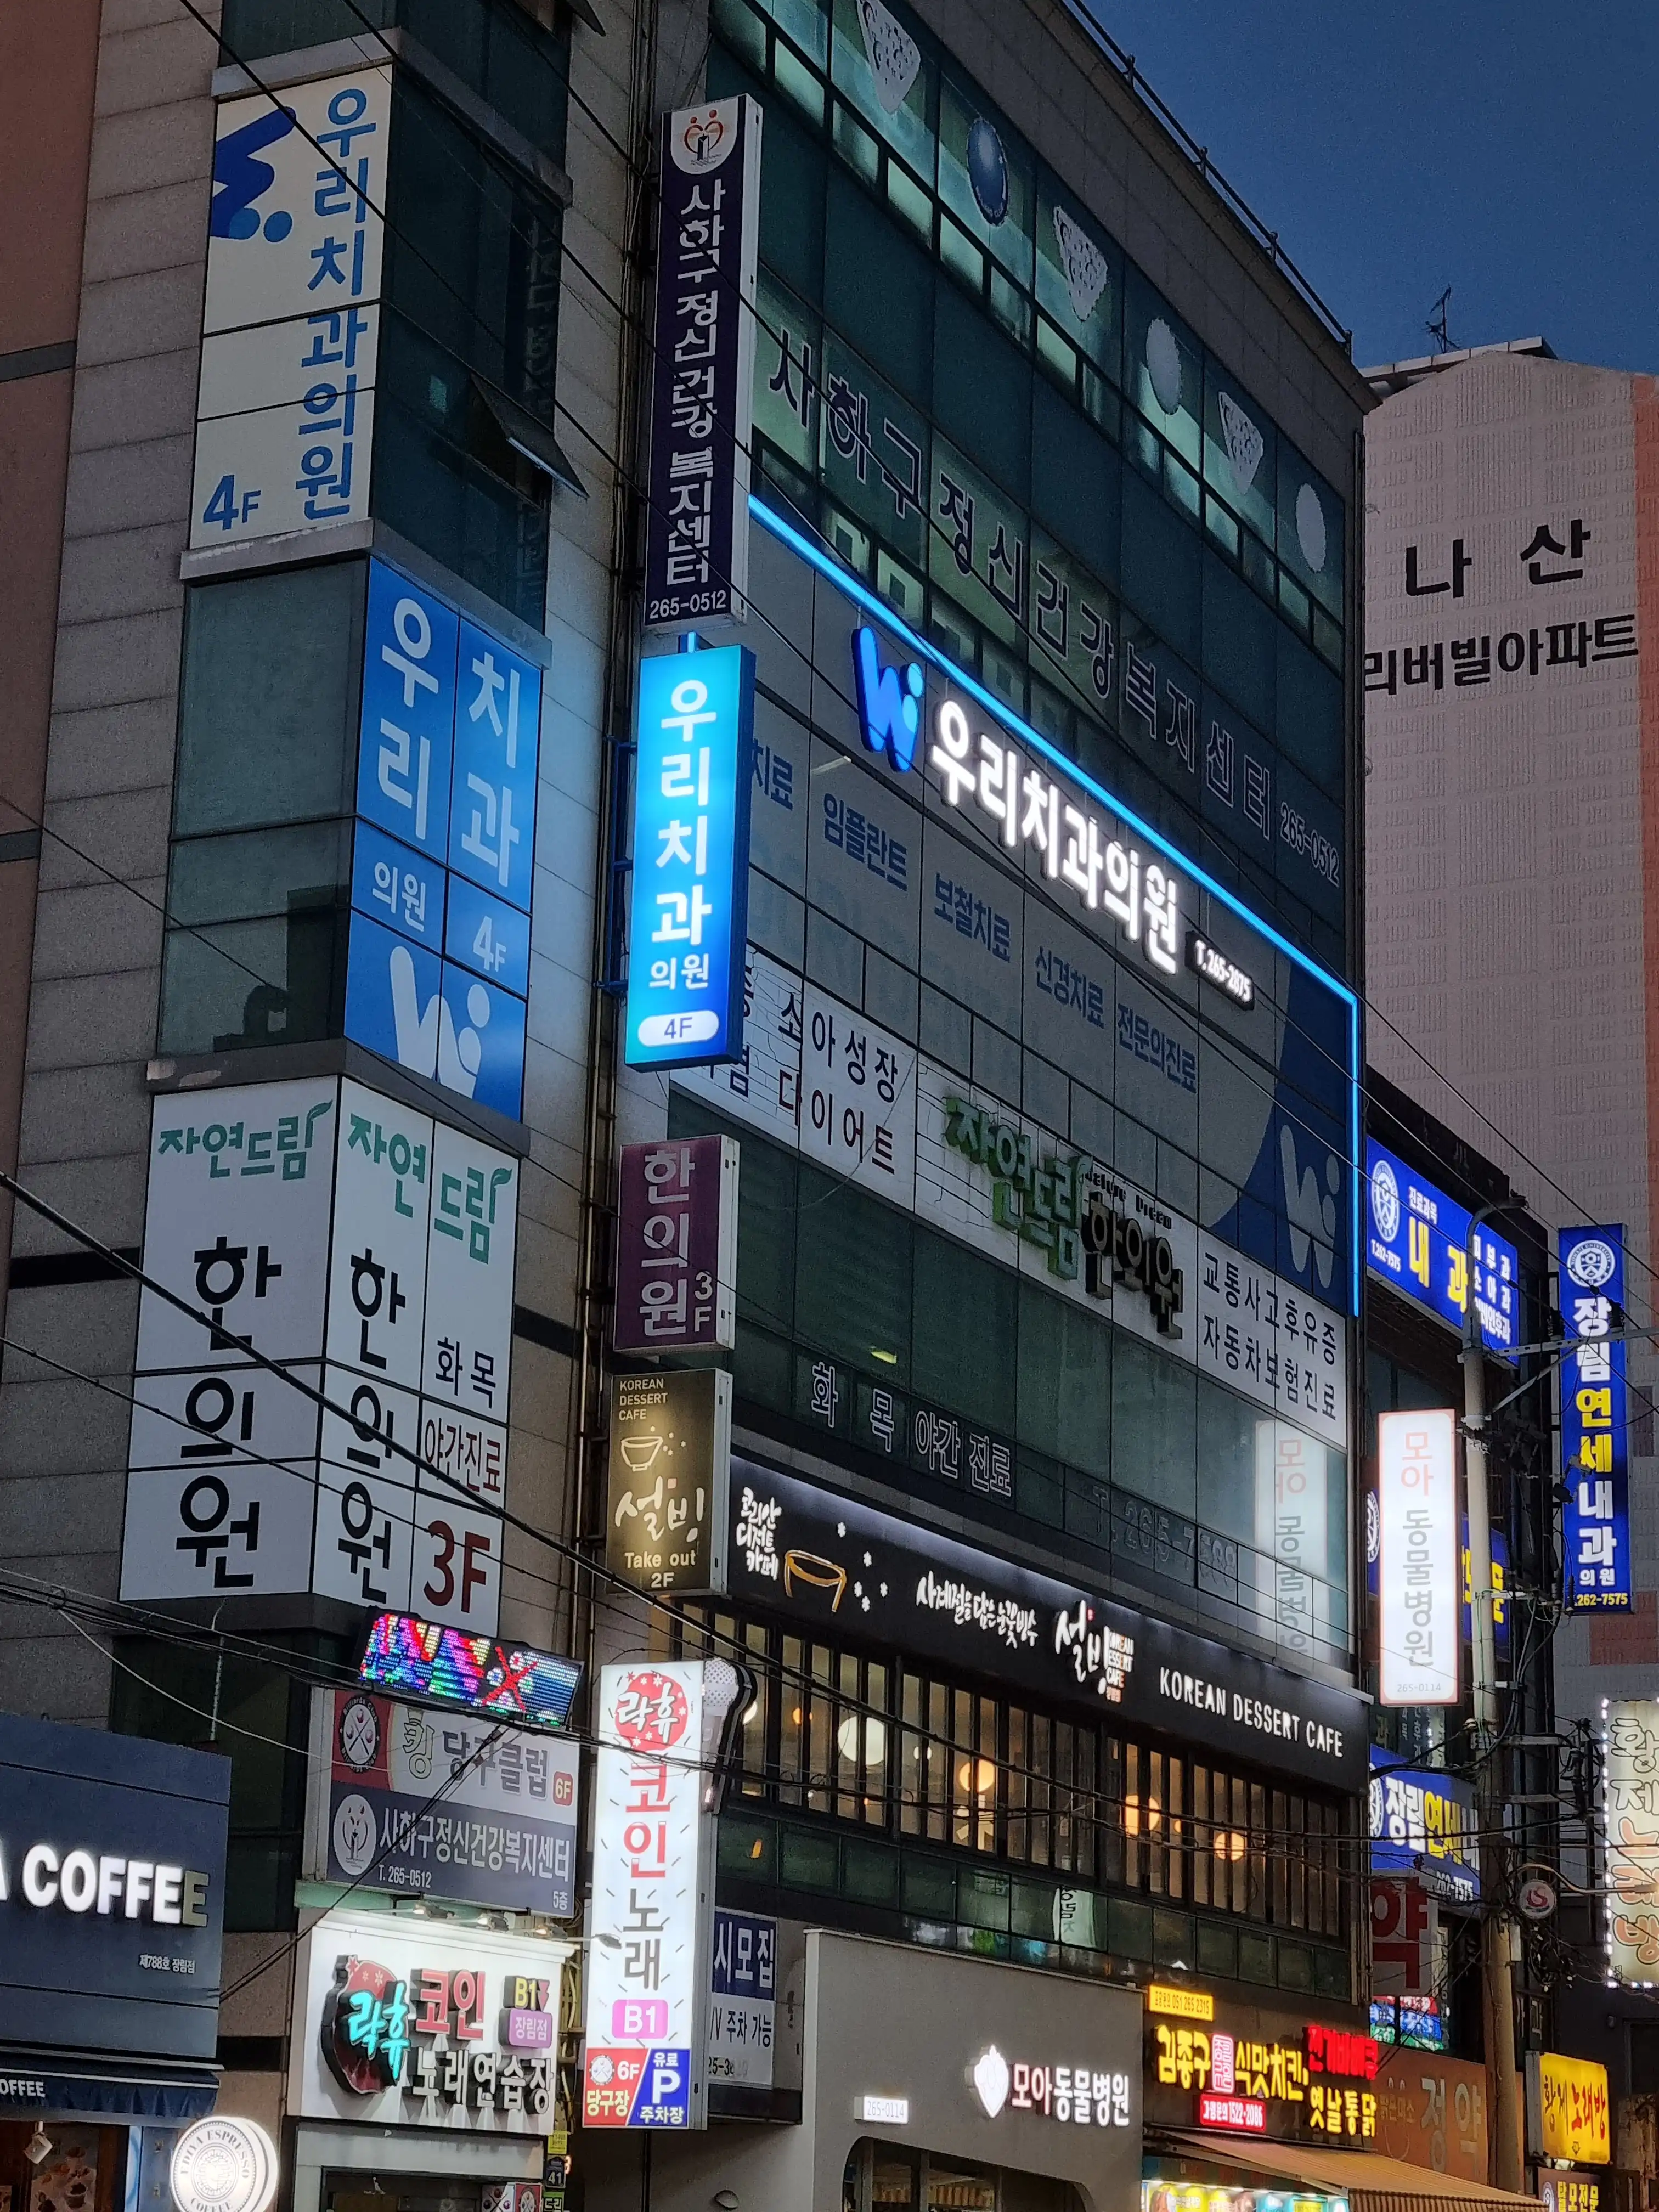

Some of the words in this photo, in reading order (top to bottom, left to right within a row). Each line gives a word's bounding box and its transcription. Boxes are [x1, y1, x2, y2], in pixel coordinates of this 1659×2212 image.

[295, 88, 376, 520] 우리치과의원
[202, 474, 261, 531] 4F
[649, 589, 727, 620] 265-0512
[651, 679, 718, 946] 우리치과
[929, 699, 1179, 975] 우리치과의원
[372, 861, 426, 933] 의원
[472, 915, 507, 973] 4F
[823, 792, 907, 892] 임플란트
[934, 873, 1011, 964] 보철치료
[1034, 945, 1104, 1030] 신경치료
[1115, 1001, 1197, 1094] 전문의진료
[648, 953, 710, 991] 의원
[663, 1017, 693, 1040] 4F
[157, 1099, 334, 1181] 자연드림
[778, 1069, 895, 1175] 다이어트
[347, 1113, 513, 1265] 자연드림
[640, 1147, 696, 1338] 한의원
[1203, 1252, 1336, 1365] 교통사고후유증
[619, 1377, 665, 1391] KOREAN
[1203, 1314, 1336, 1421] 자동차보험진료
[176, 1235, 282, 1590] 한의원
[618, 1408, 647, 1421] CAFE
[619, 1392, 669, 1406] DESSERT
[337, 1248, 407, 1605] 한의원
[424, 1416, 502, 1496] 야간진료
[1401, 1431, 1434, 1497] 모아
[614, 1475, 706, 1543] 설빙
[423, 1519, 492, 1614] 3F
[624, 1551, 662, 1570] Take
[669, 1550, 696, 1567] out
[651, 1572, 675, 1589] 2F
[1579, 1568, 1616, 1587] 의원
[1402, 1509, 1434, 1668] 동물병원
[1159, 1666, 1227, 1717] KOREAN
[1233, 1692, 1300, 1742] DESSERT
[1306, 1720, 1344, 1758] CAFE
[1396, 1681, 1442, 1694] 265-0114
[555, 1778, 572, 1800] 6F
[21, 1842, 211, 1927] COFFEE
[387, 1866, 432, 1889] 265-0512
[551, 1890, 568, 1911] 5층
[172, 1957, 196, 1975] 장림점
[414, 1968, 486, 2041] 코인
[514, 1977, 536, 2011] B1
[623, 2005, 656, 2033] B1
[348, 1979, 411, 2081] 락휴
[514, 2015, 548, 2042] 장림점
[726, 2010, 747, 2045] 주차
[752, 2013, 772, 2048] 가능
[412, 2046, 555, 2115] 노래연습장
[617, 2060, 640, 2080] 6F
[653, 2052, 679, 2068] 유료
[1156, 2024, 1211, 2090] 김종구
[586, 2090, 630, 2117] 당구장
[652, 2069, 681, 2104] P
[866, 2100, 905, 2119] 265-0114
[1310, 2086, 1378, 2137] 옛날통닭
[640, 2106, 685, 2125] 주차장
[206, 2129, 251, 2179] ESPRESSO
